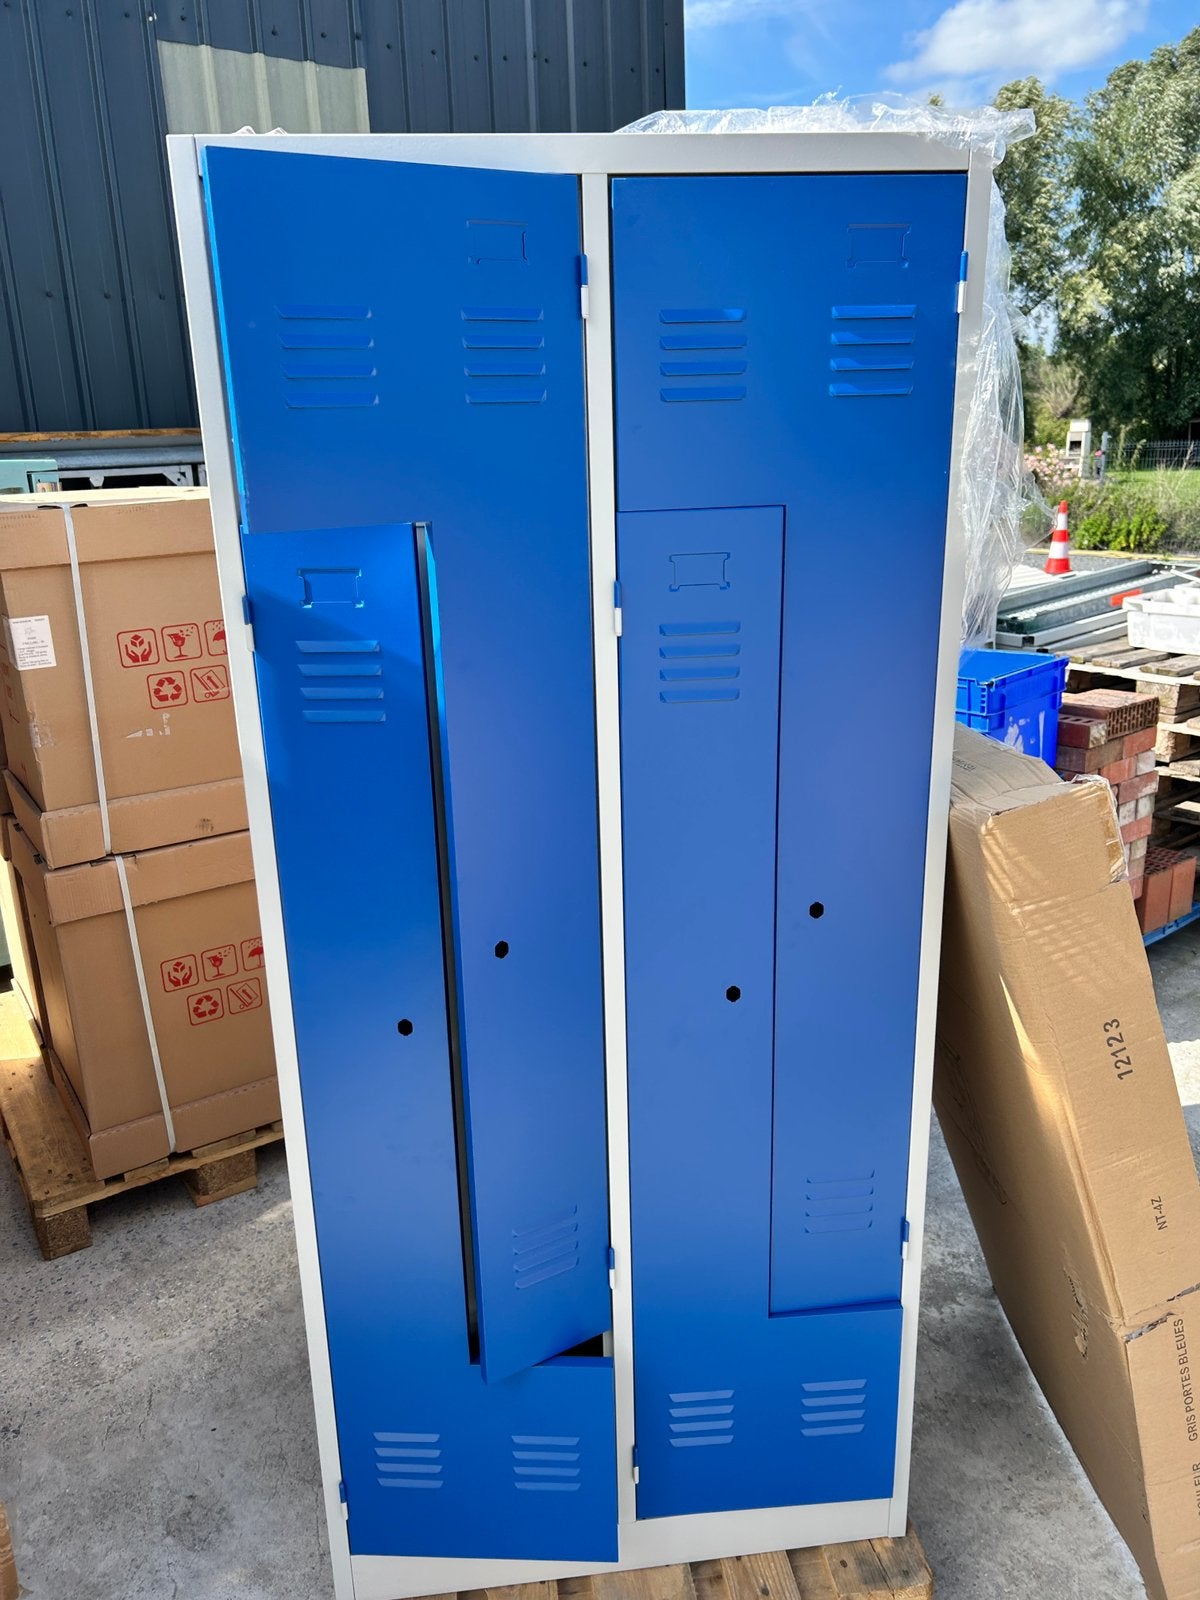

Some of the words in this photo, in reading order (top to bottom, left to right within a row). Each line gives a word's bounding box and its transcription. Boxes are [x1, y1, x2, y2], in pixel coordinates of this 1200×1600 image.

[1103, 1018, 1133, 1080] 12123
[1151, 1196, 1167, 1230] NT-4Z
[1174, 1318, 1189, 1365] BLEUES
[1180, 1366, 1195, 1413] PORTES
[1186, 1414, 1198, 1441] GRIS
